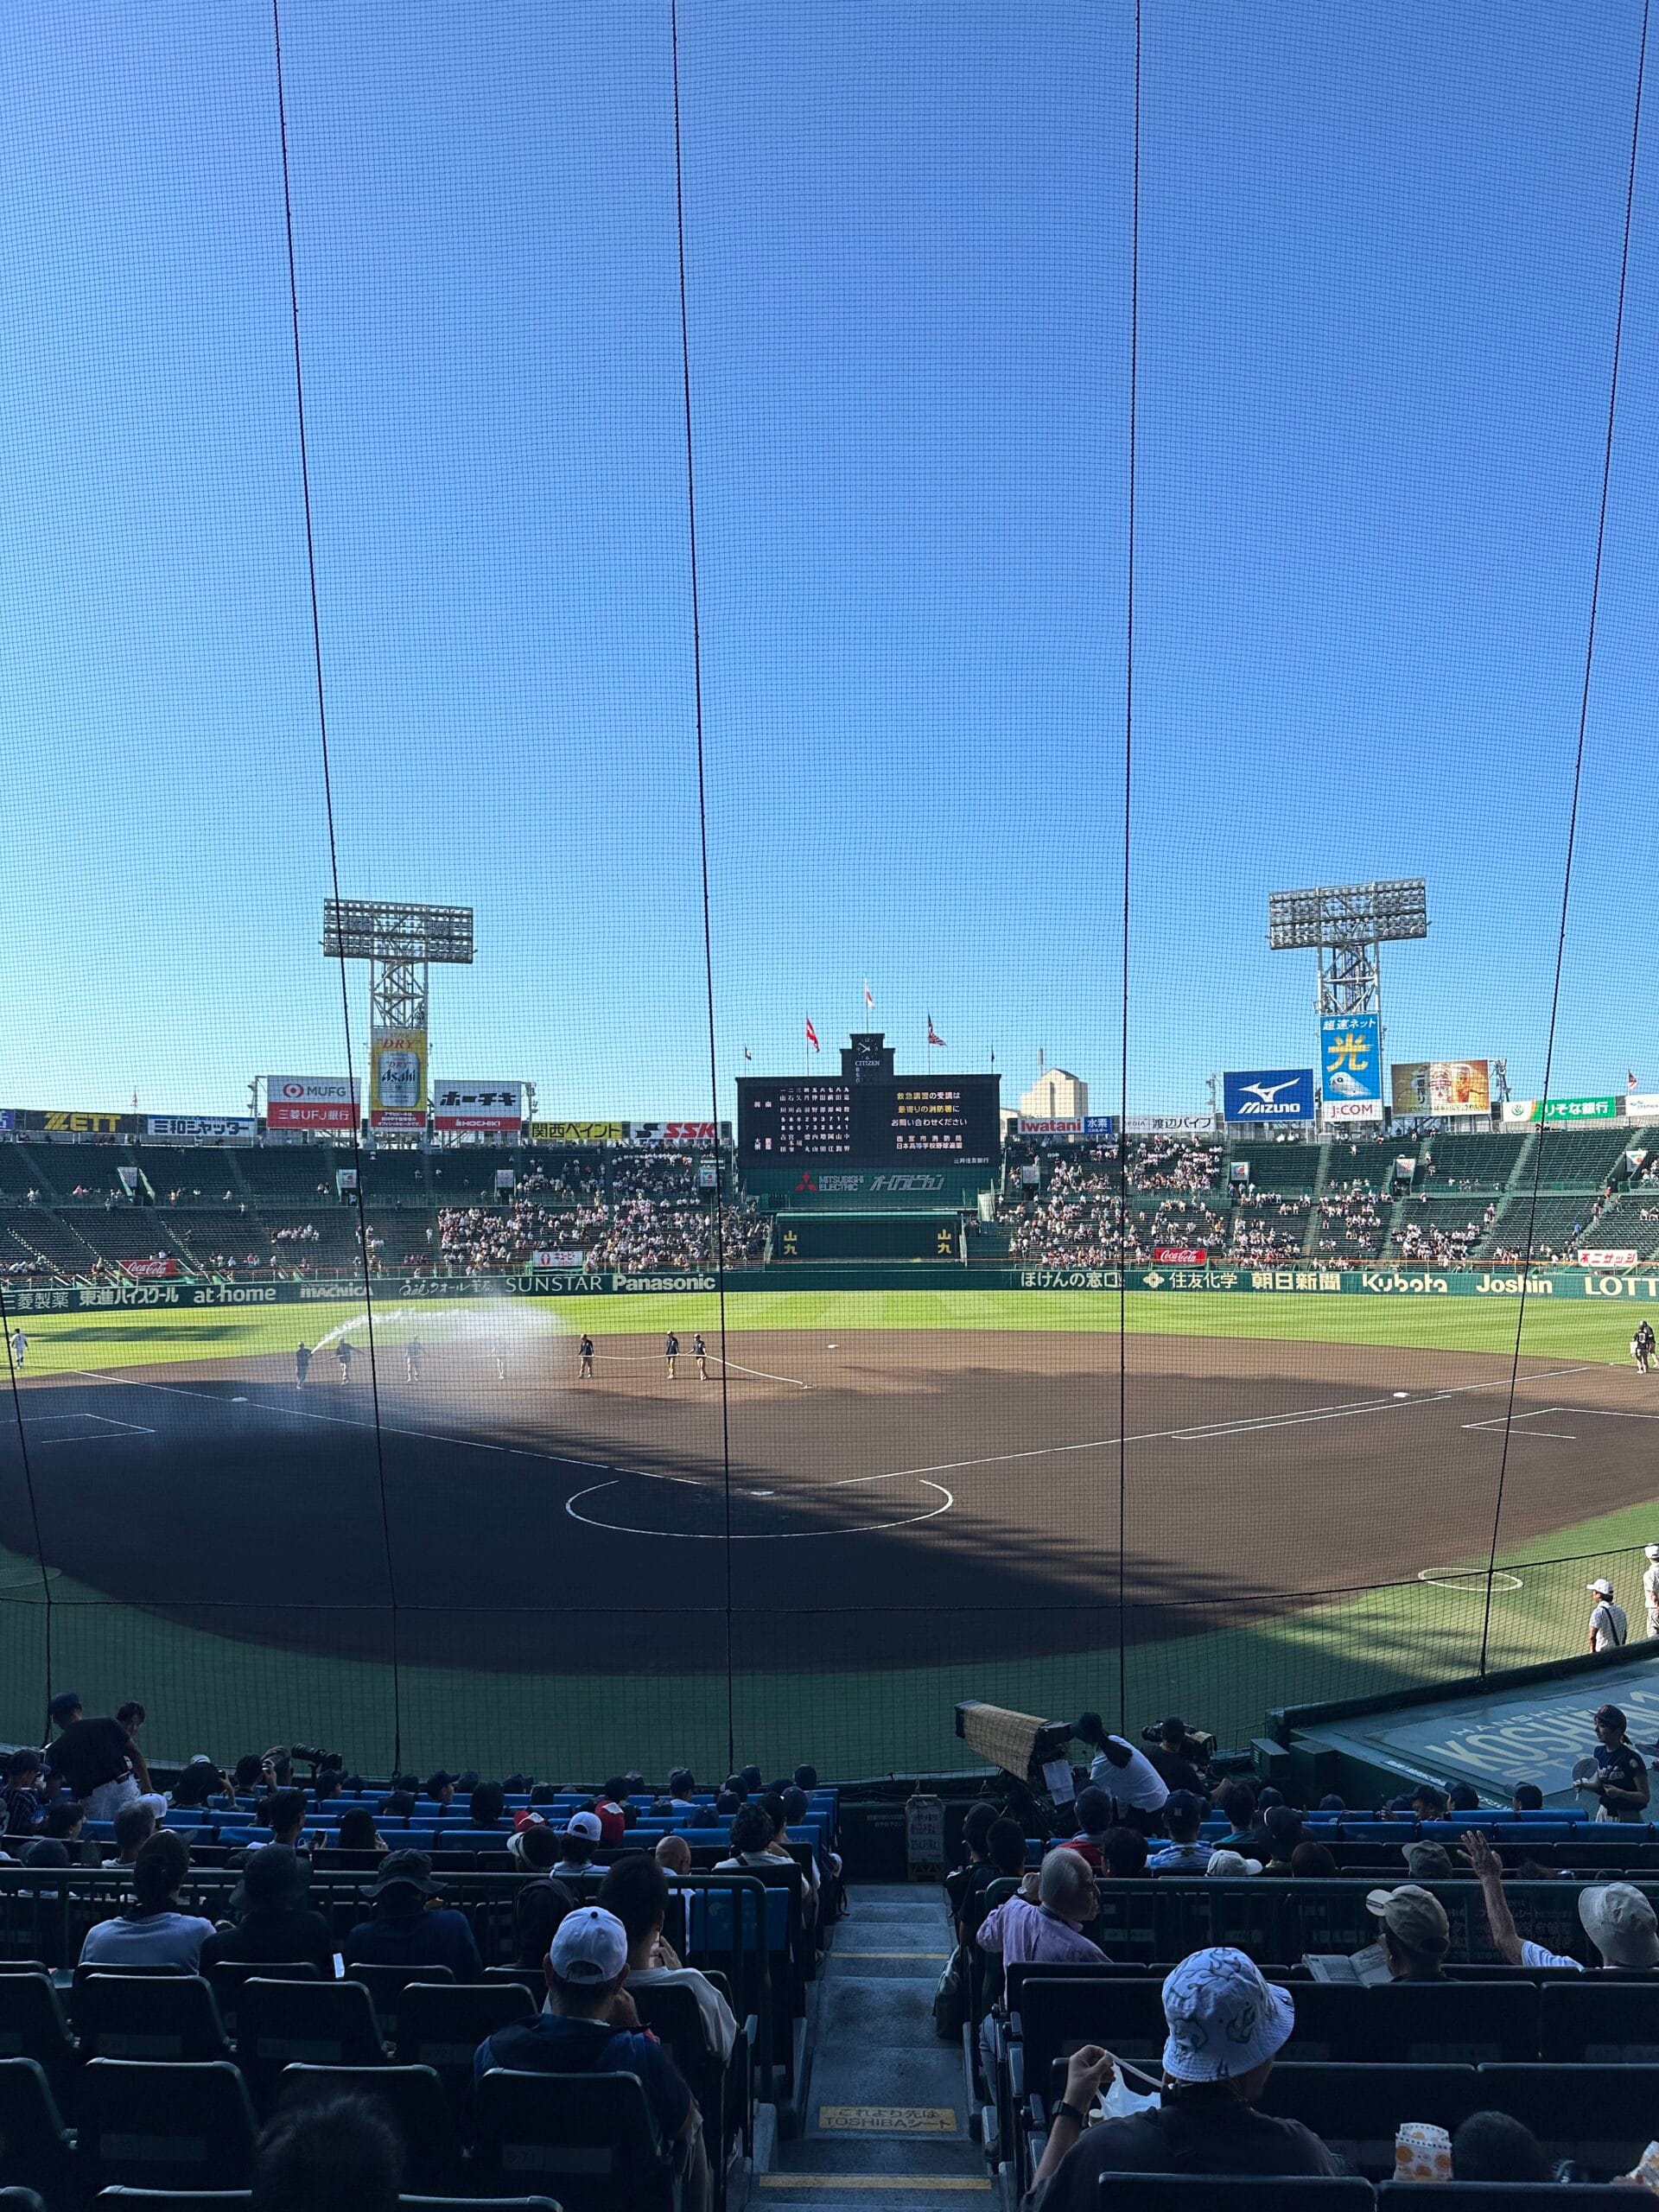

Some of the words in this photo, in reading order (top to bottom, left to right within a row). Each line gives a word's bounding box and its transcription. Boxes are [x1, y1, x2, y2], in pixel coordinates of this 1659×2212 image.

[1326, 1033, 1372, 1071] 光
[381, 1069, 416, 1082] Asahi
[307, 1085, 346, 1096] MUFG
[440, 1090, 517, 1106] ホーチキ
[278, 1109, 349, 1121] 三菱UFJ銀行
[1332, 1104, 1373, 1118] J:COM
[43, 1111, 121, 1133] ZETT
[532, 1122, 621, 1138] 関西ペイント
[664, 1122, 715, 1138] SSK
[1021, 1119, 1081, 1132] Iwatani
[1087, 1118, 1108, 1128] 水素
[505, 1275, 602, 1293] SUNSTAR
[613, 1274, 716, 1291] Panasonic
[1020, 1271, 1118, 1288] ほけんの窓口
[1169, 1272, 1238, 1289] 住友化学
[1251, 1273, 1340, 1290] 朝日新聞
[1362, 1274, 1447, 1293] Kubota
[1476, 1274, 1553, 1294] Joshin
[79, 1287, 180, 1306] 東進ハイスクール
[194, 1287, 215, 1303] at
[216, 1283, 276, 1302] home
[1450, 1706, 1579, 1736] HANSHIN
[839, 2109, 938, 2119] これより先は
[825, 2117, 951, 2129] TOSHIBAシート
